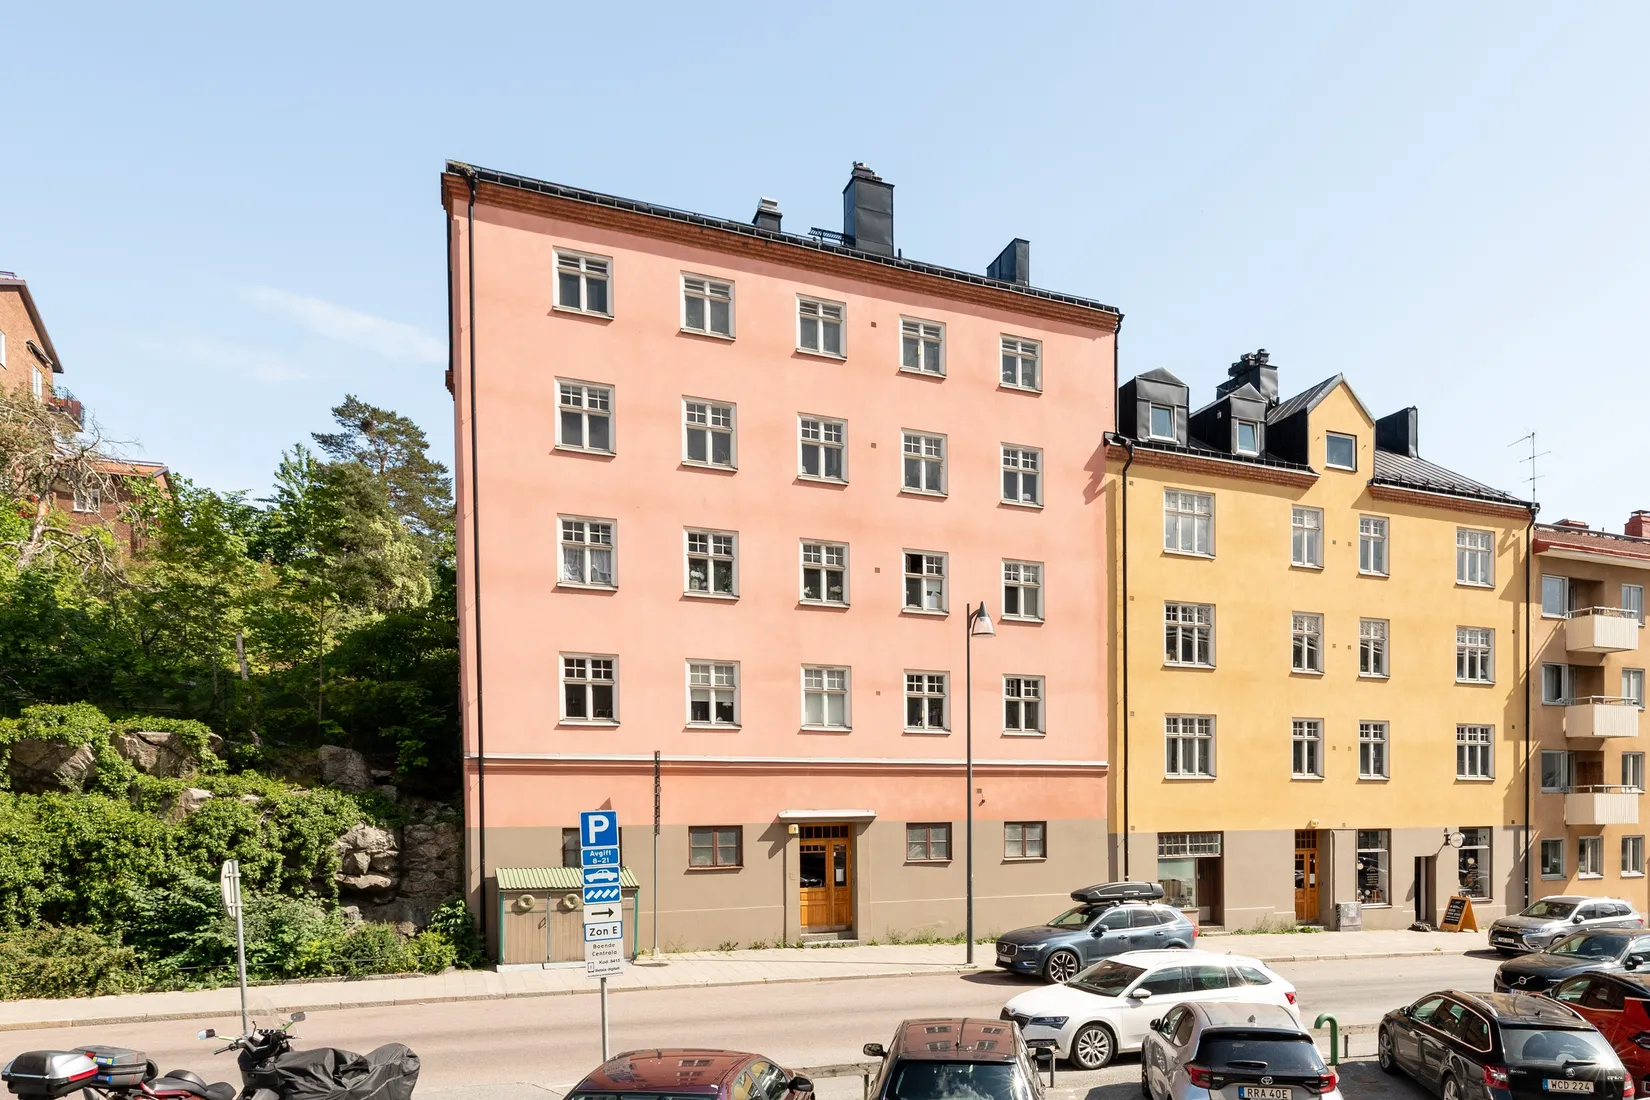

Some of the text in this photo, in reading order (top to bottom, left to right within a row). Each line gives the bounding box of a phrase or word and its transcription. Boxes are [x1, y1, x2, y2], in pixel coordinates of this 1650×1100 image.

[588, 815, 609, 843] P
[589, 926, 618, 936] Zon E
[1551, 1081, 1590, 1091] WCD 224
[1247, 1088, 1288, 1098] RRA 40E
